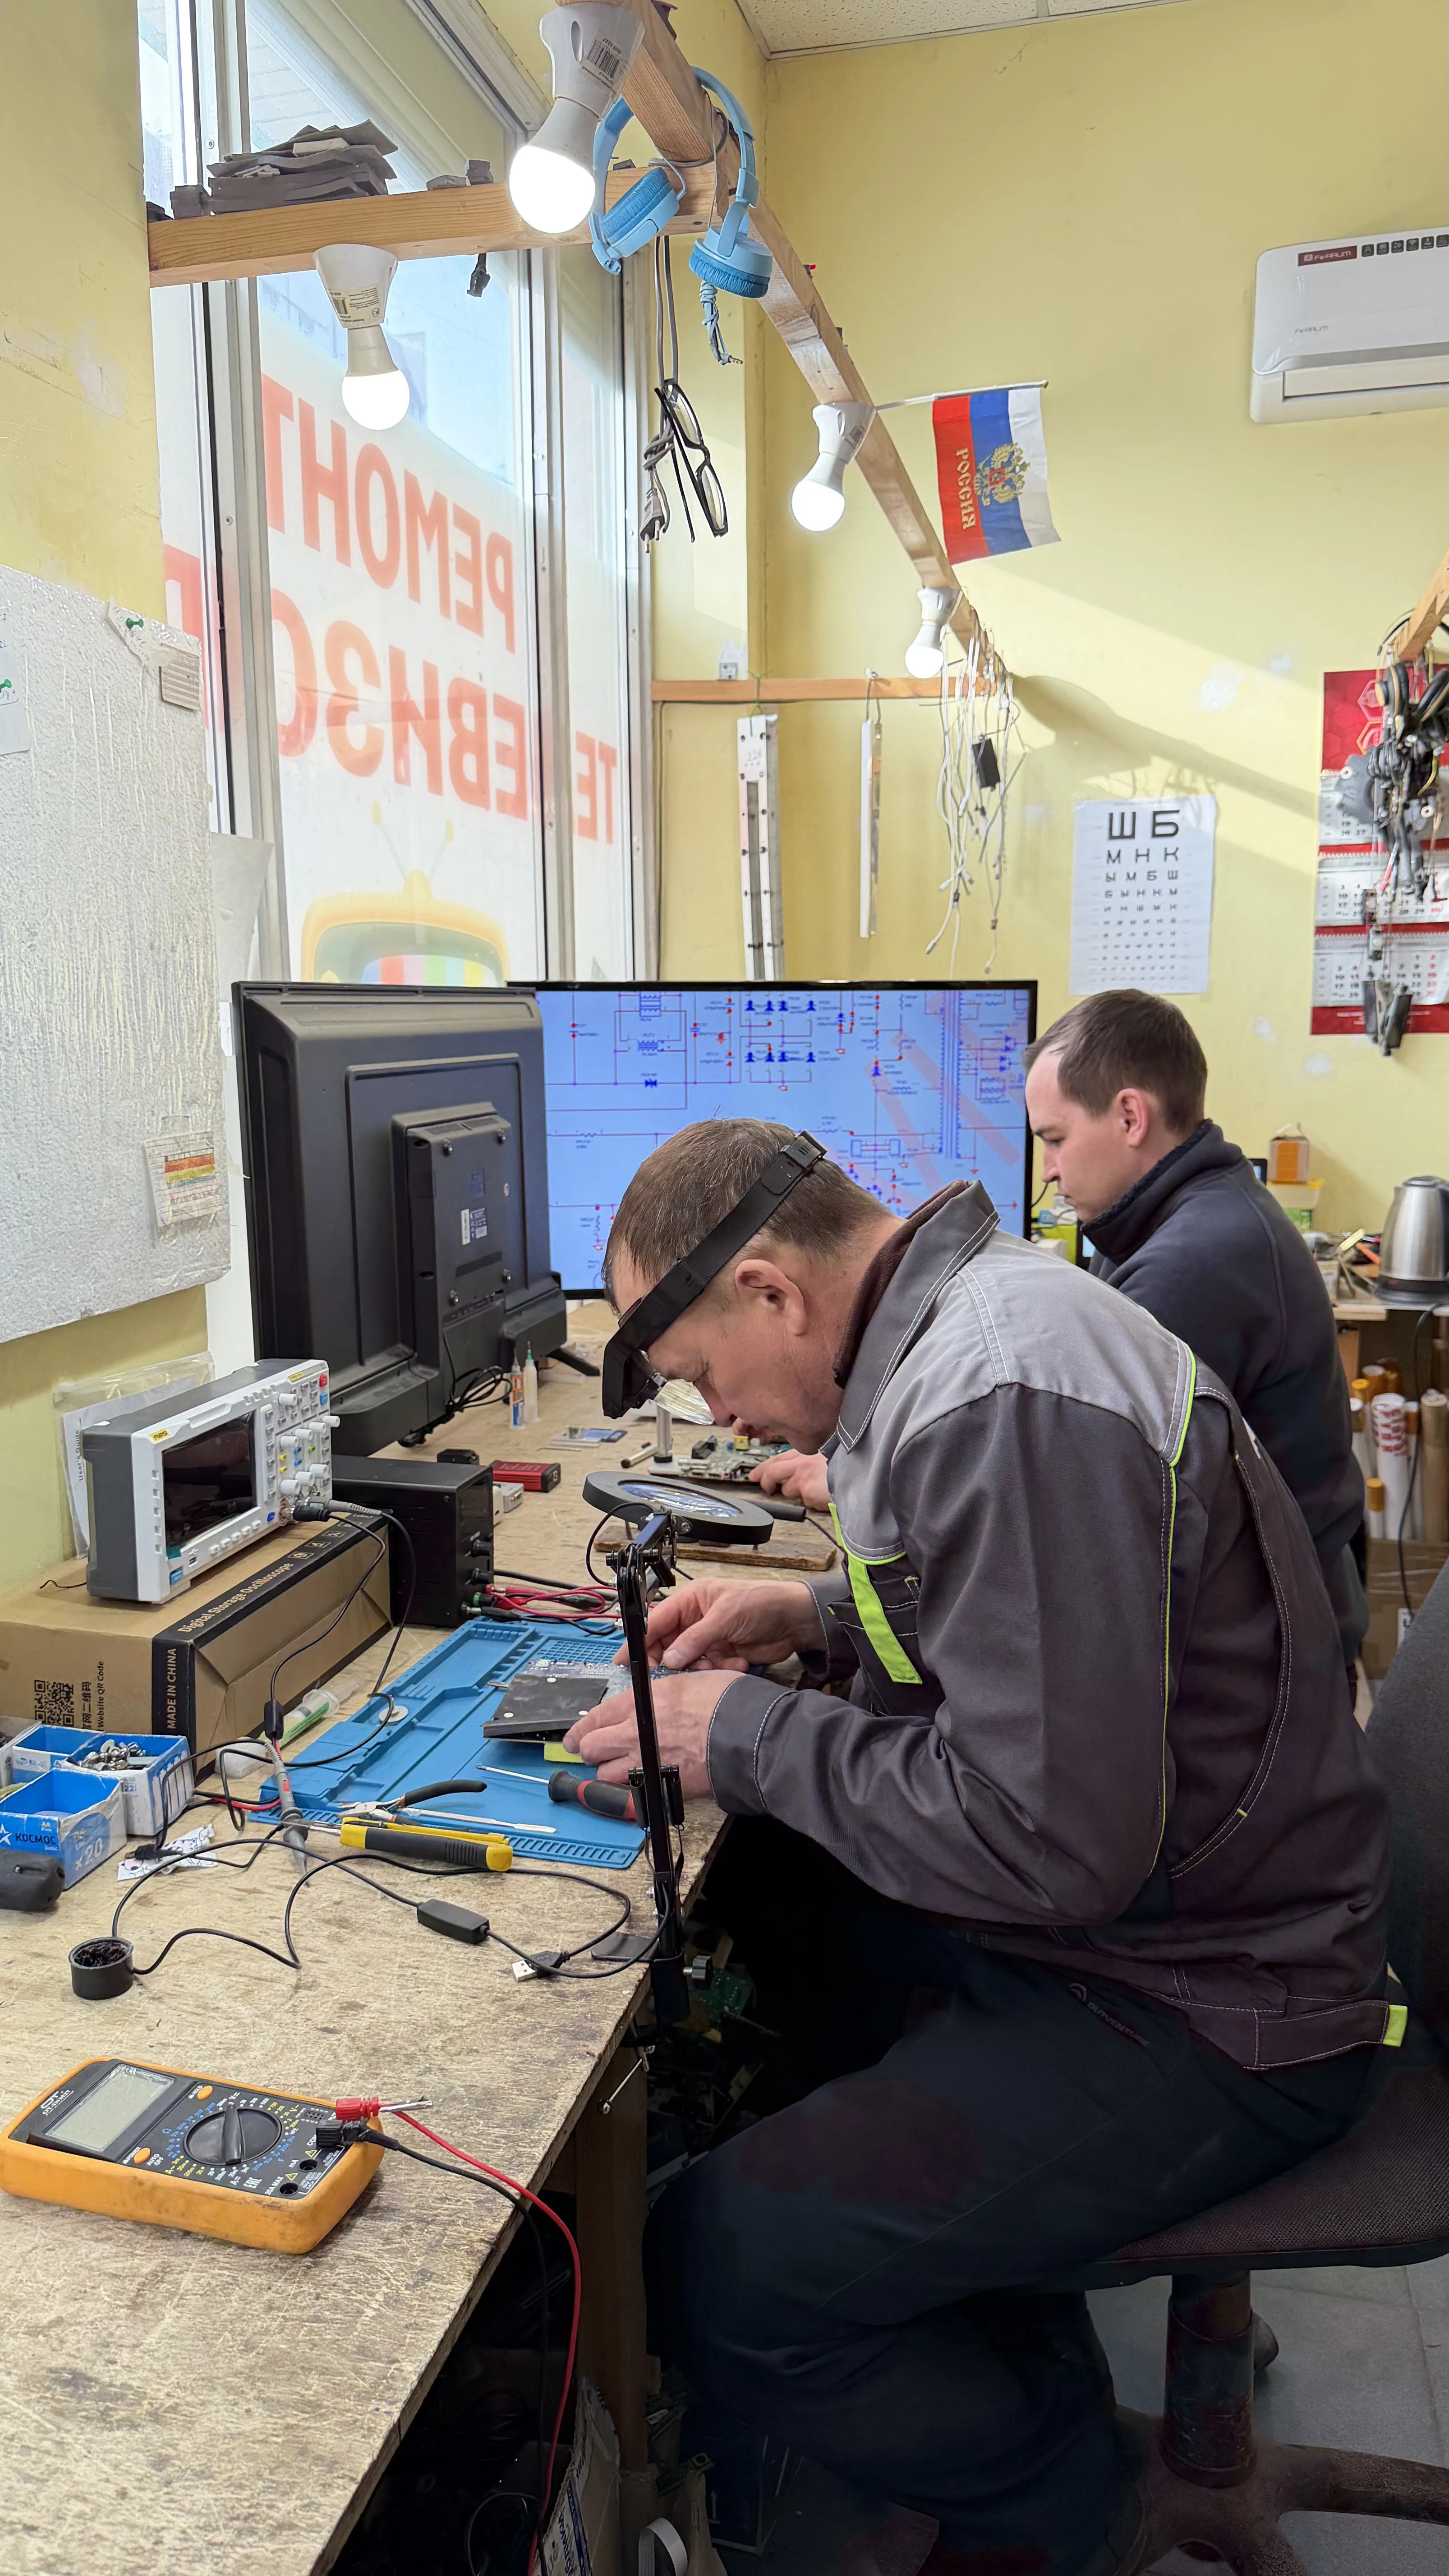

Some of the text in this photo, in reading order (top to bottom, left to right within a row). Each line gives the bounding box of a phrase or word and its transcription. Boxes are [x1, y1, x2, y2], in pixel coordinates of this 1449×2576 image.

[955, 447, 976, 530] РОССИЯ
[1108, 810, 1180, 840] Ш Б
[1106, 846, 1179, 864] М Н К
[1105, 869, 1178, 882] Ы М Б Ш
[177, 1563, 294, 1633] Digital Storage Oscilloscope
[97, 1683, 105, 1695] QR
[167, 1648, 176, 1730] MADE IN CHINA
[15, 1832, 57, 1845] КОСМОС
[145, 2153, 161, 2166] AUTO
[153, 2156, 166, 2165] OFF
